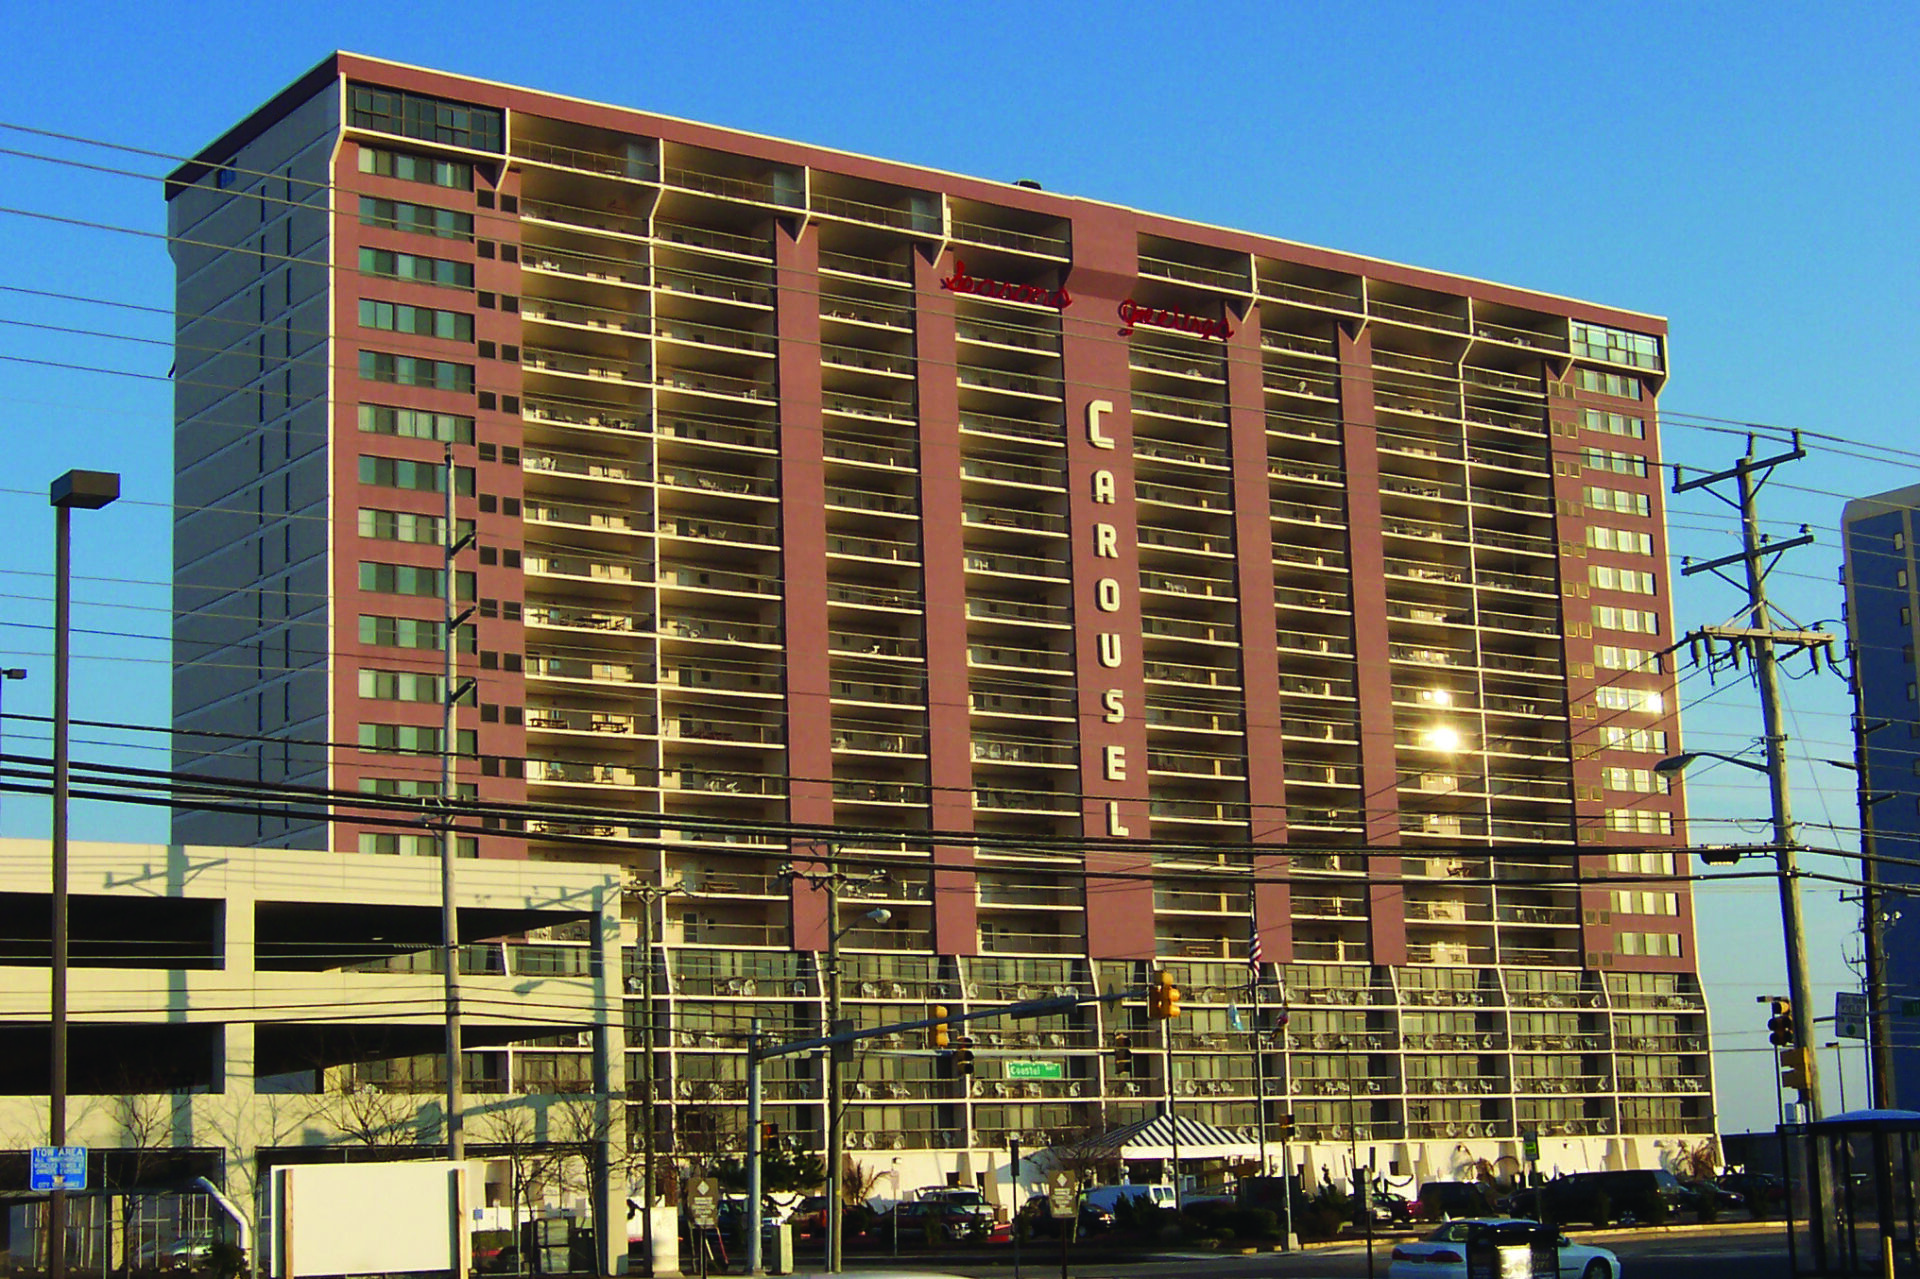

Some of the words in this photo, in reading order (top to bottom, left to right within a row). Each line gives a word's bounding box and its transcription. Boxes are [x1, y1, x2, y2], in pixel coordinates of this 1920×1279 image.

[1088, 400, 1129, 837] CAROUSEL
[1010, 1066, 1040, 1075] Coastal
[35, 1148, 54, 1157] TOW
[58, 1148, 83, 1157] AREA
